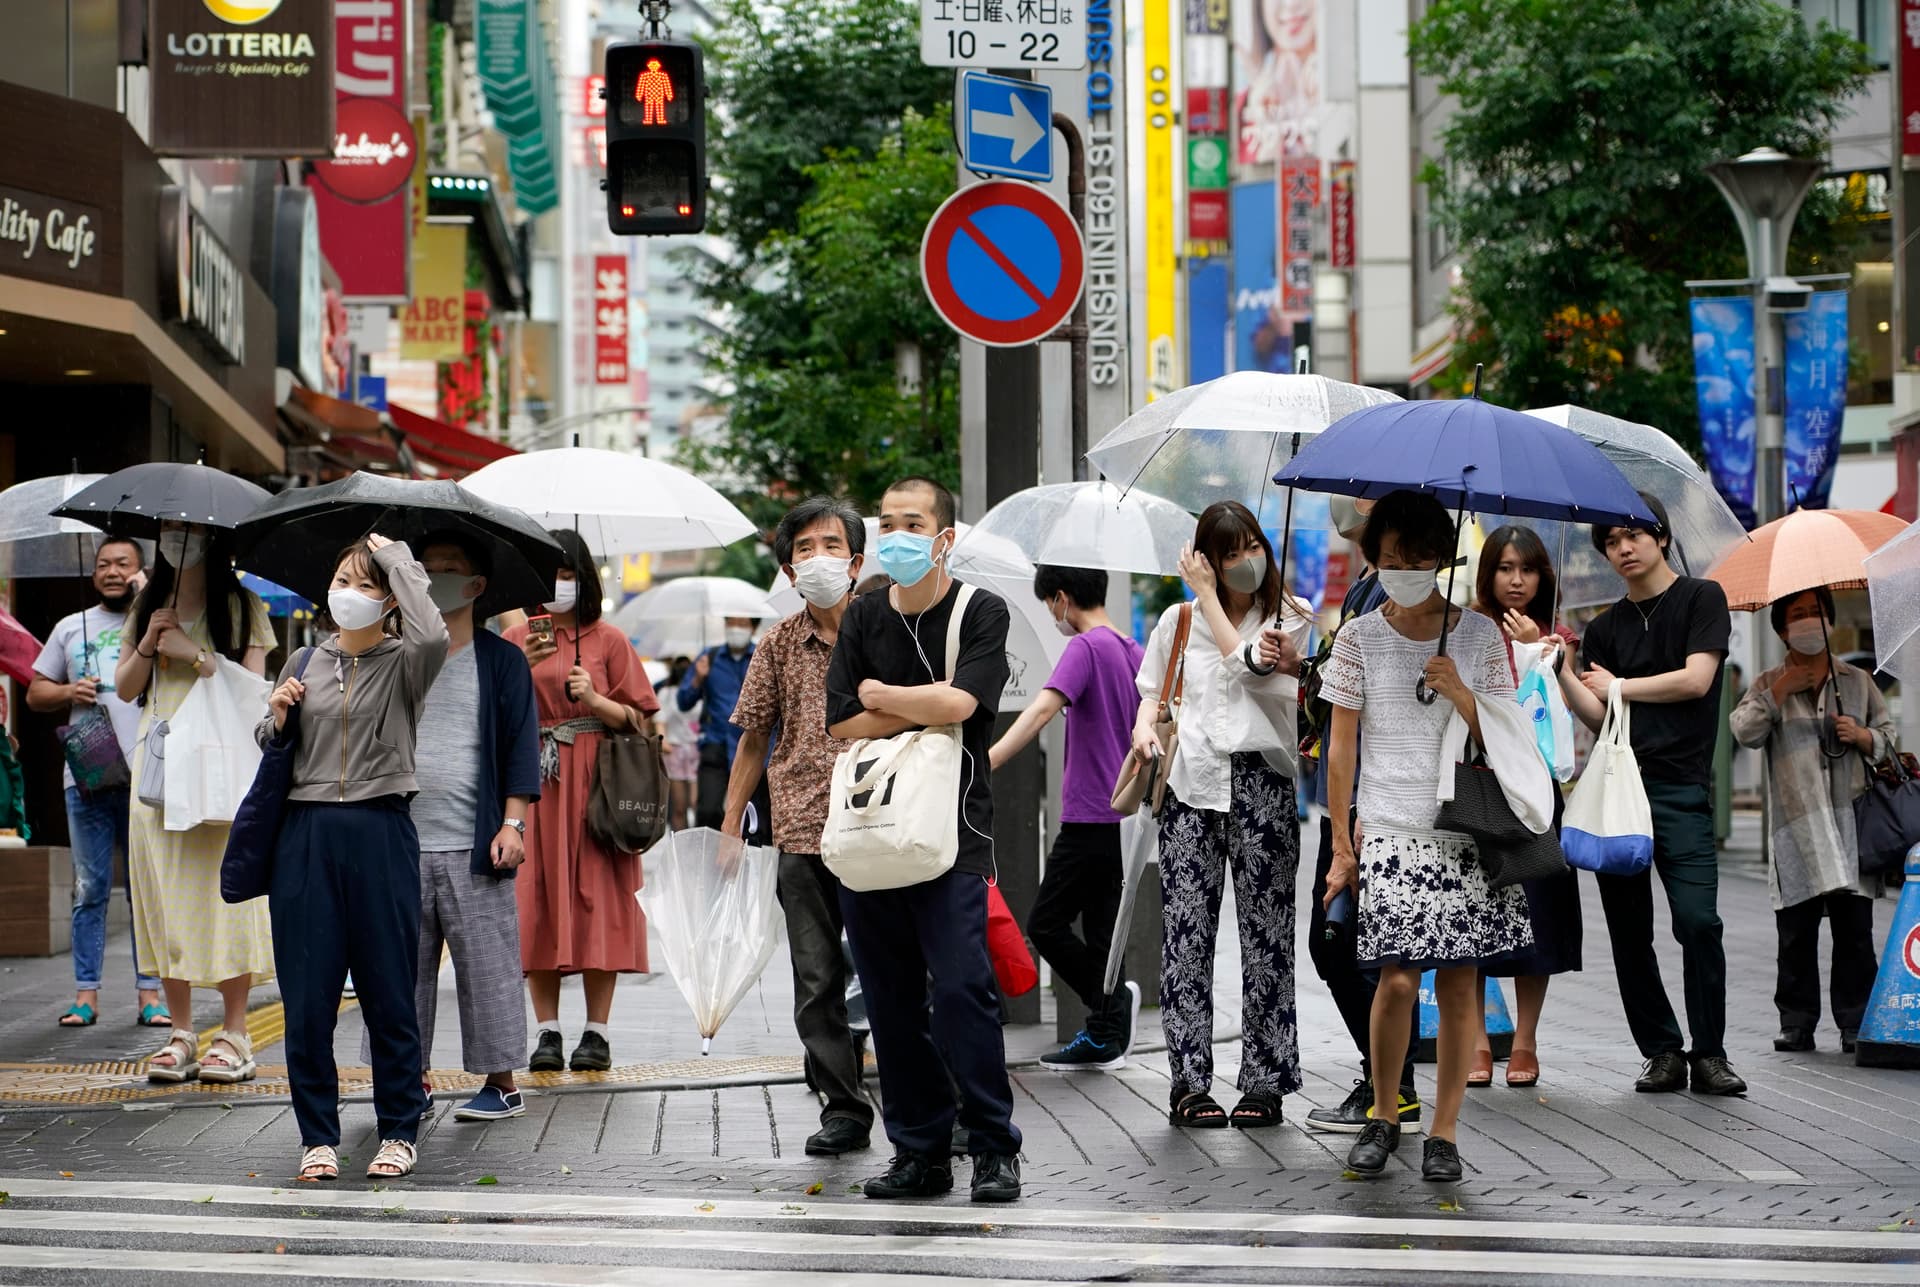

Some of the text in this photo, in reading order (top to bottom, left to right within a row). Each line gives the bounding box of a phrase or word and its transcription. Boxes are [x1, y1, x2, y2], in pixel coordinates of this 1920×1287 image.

[167, 33, 315, 57] LOTTERIA
[948, 30, 975, 59] 10
[1020, 32, 1059, 62] 22
[228, 61, 283, 77] Speciality
[283, 62, 310, 77] Cafe
[1087, 71, 1113, 118] TO
[334, 132, 409, 165] hakey's
[1088, 123, 1115, 167] ST
[0, 198, 95, 268] lity Cafe
[192, 214, 245, 368] LOTTERIA
[1089, 176, 1119, 385] SUNSHINE60
[404, 296, 459, 322] ABC
[404, 325, 457, 343] MART
[619, 800, 666, 813] BEAUTY
